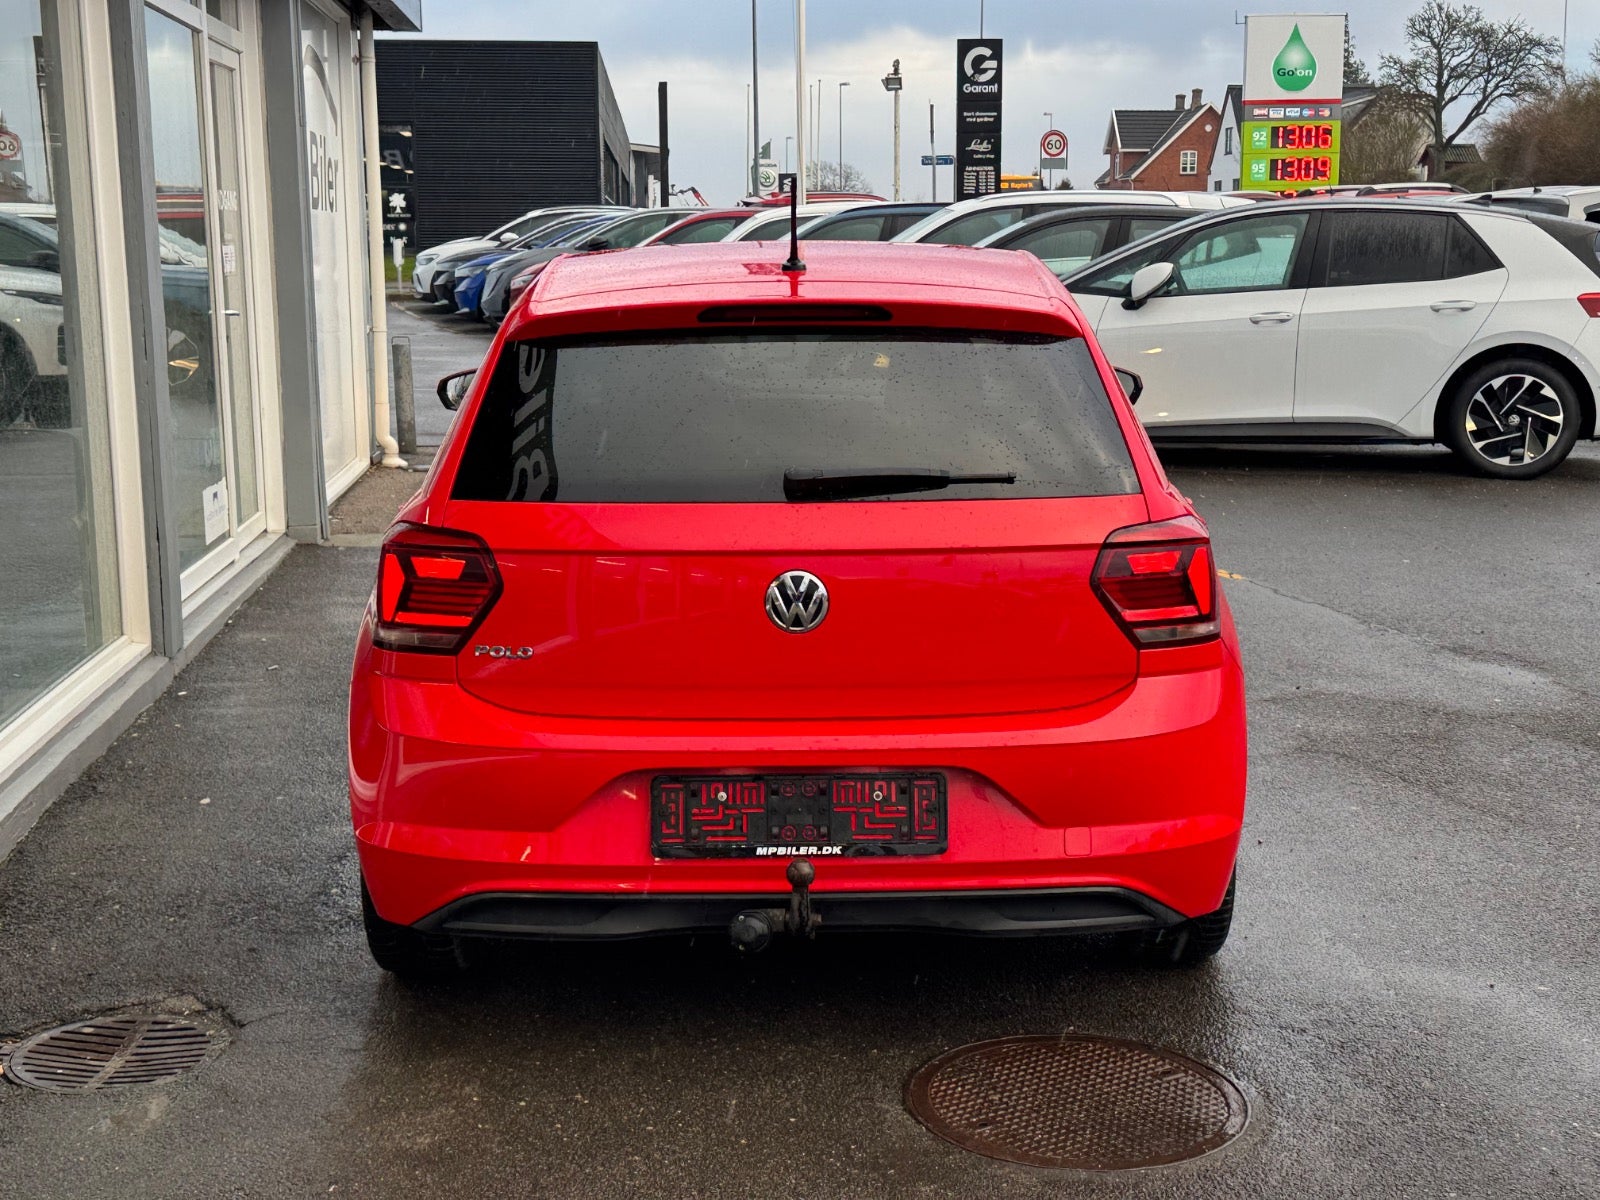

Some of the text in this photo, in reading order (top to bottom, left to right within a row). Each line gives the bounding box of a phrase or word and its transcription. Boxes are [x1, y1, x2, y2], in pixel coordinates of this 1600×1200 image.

[963, 83, 998, 93] Garant
[1252, 131, 1267, 141] 92
[1046, 139, 1062, 150] 60
[310, 130, 339, 214] Biler
[1251, 163, 1266, 173] 95
[474, 644, 534, 660] POLO
[755, 845, 842, 856] MPBILER.DK
